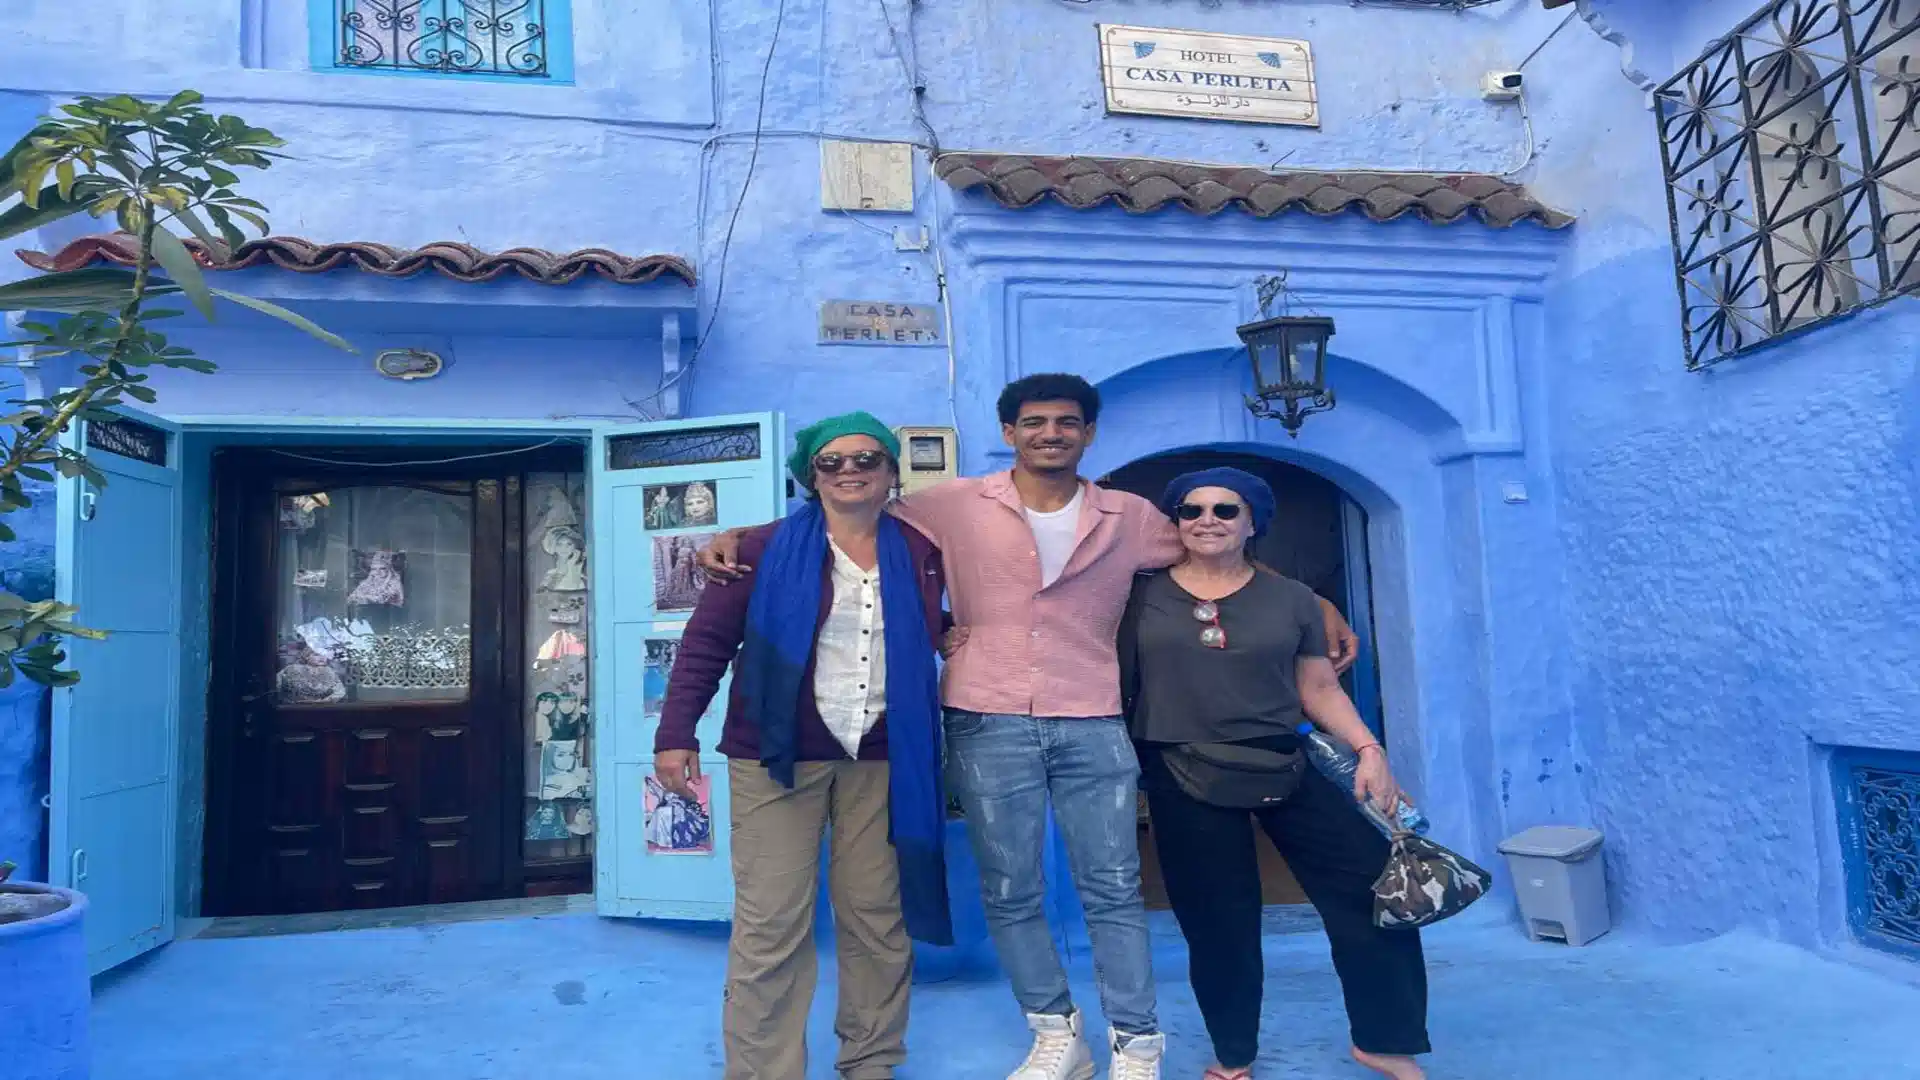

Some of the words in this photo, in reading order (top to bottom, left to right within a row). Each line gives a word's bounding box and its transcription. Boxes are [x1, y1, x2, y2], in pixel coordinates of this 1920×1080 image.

[1180, 50, 1237, 64] HOTEL
[1126, 67, 1183, 84] CASA
[1192, 72, 1293, 92] PERLETA
[1231, 97, 1250, 109] دار
[849, 304, 914, 317] CASA
